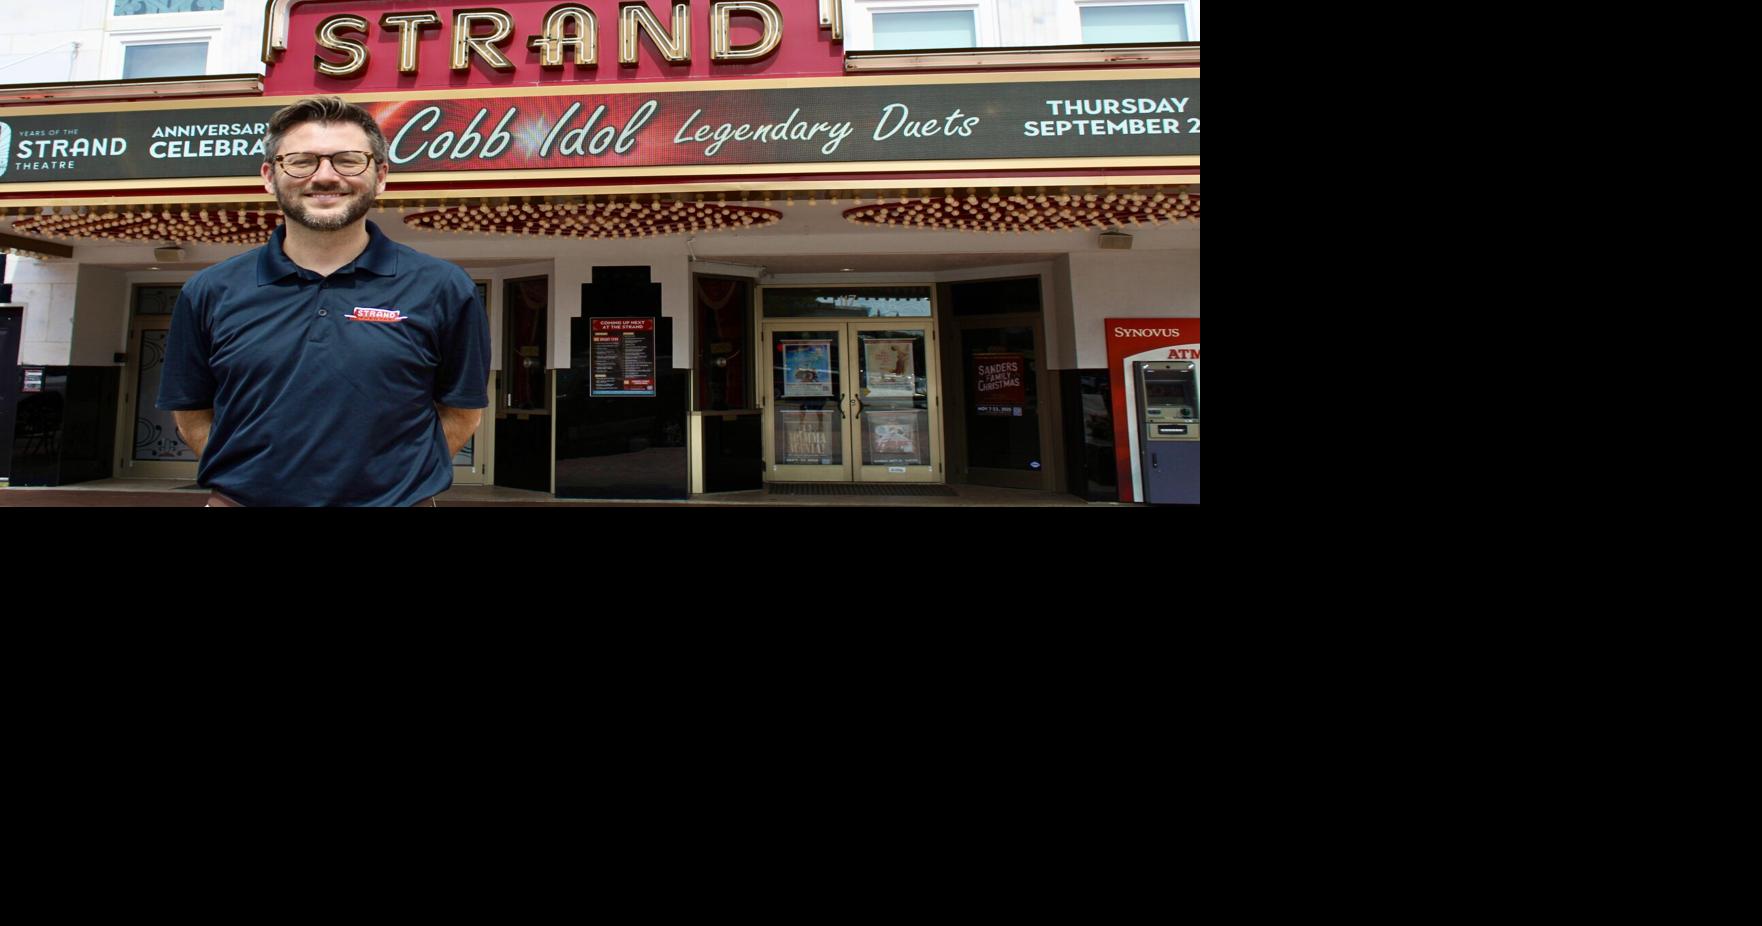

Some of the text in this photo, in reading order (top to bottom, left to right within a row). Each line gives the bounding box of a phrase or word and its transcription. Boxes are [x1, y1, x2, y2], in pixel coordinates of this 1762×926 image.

[314, 0, 784, 75] STRAND
[1046, 97, 1189, 116] THURSDAY
[388, 99, 658, 164] Cobb Idol
[673, 103, 980, 157] Legendary Duets
[1024, 118, 1180, 137] SEPTEMBER
[16, 136, 127, 159] STRAND
[15, 160, 75, 171] THEATRE
[357, 310, 396, 318] STRAND
[1114, 327, 1180, 337] SYNOVUS
[978, 361, 1018, 376] SANDERS
